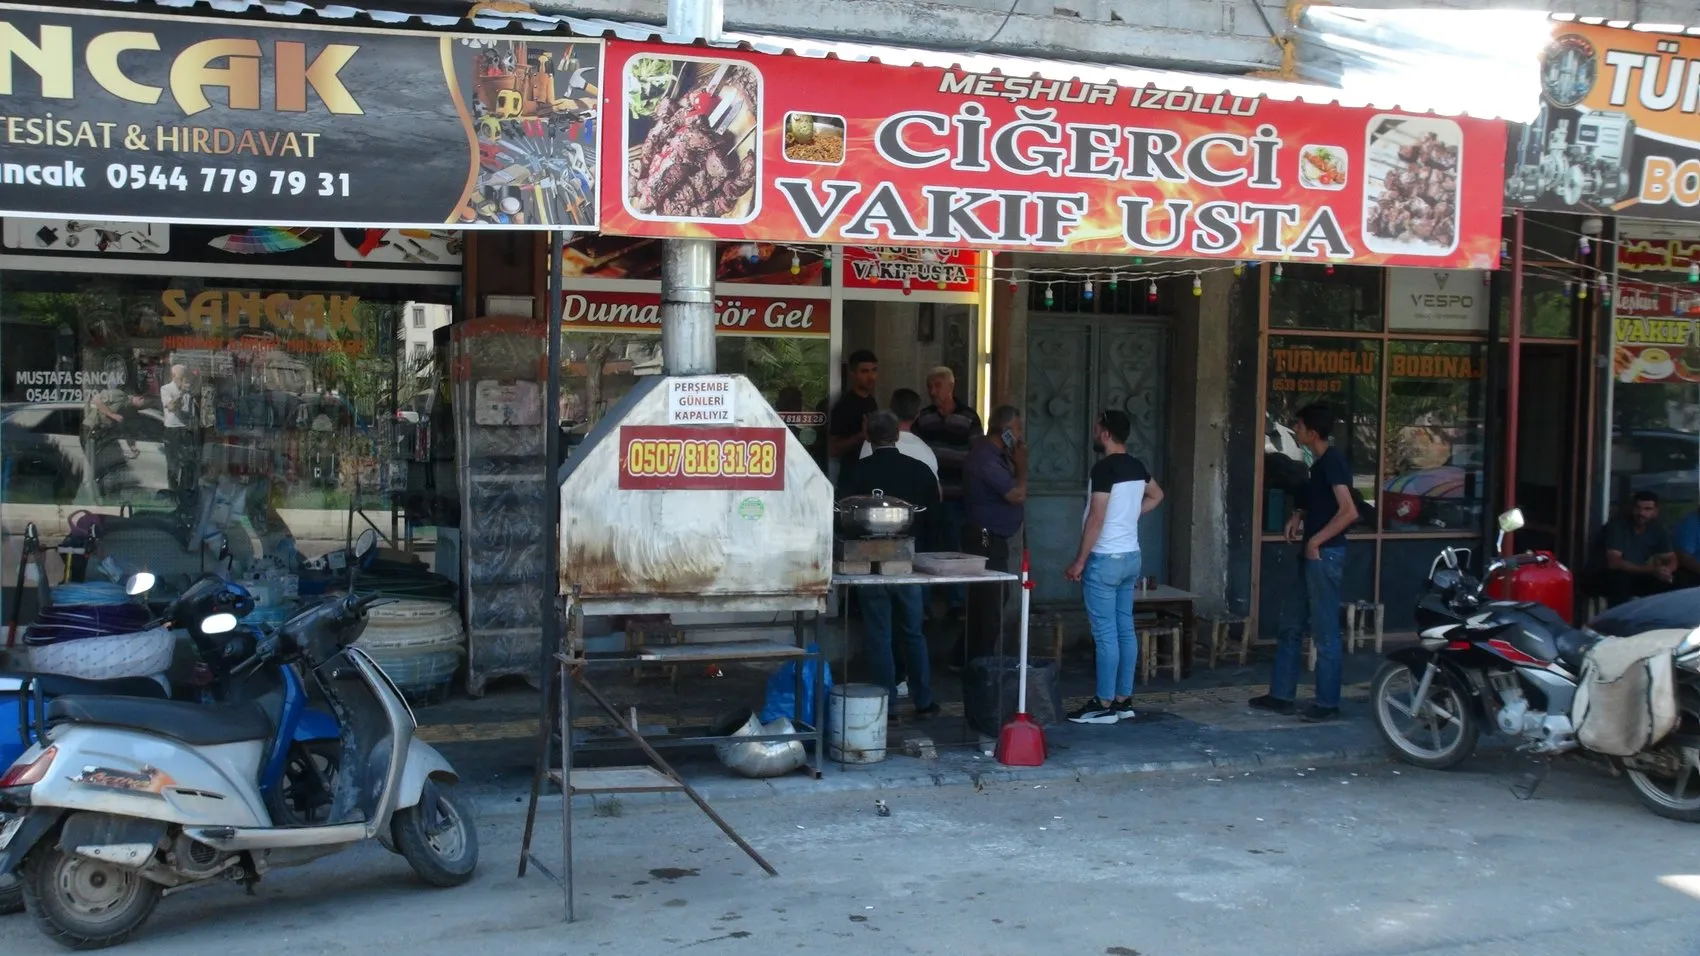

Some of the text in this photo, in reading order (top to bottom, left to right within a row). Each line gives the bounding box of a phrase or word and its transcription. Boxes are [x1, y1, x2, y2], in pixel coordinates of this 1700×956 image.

[0, 21, 365, 116] NCAK
[938, 72, 1118, 105] MEŞHUR
[124, 124, 149, 150] &
[157, 125, 321, 159] HIRDAVAT
[875, 103, 1283, 190] CİĞERCİ
[0, 160, 351, 197] ncak 0544 779 79 31
[1638, 156, 1700, 207] BO
[775, 177, 1354, 260] VAKIF USTA
[916, 263, 969, 283] USTA
[161, 289, 361, 333] SANCAK
[562, 294, 662, 324] Duma
[764, 302, 813, 328] Gel
[1410, 293, 1473, 308] VESPO
[16, 371, 126, 386] MUSTAFA SANCAK
[26, 388, 59, 402] 0544
[60, 388, 82, 402] 779
[674, 382, 729, 395] PERŞEMBE
[674, 410, 729, 421] KAPALIYIZ
[679, 394, 724, 406] GÜNLERİ
[628, 439, 777, 477] 0507 818 31 28
